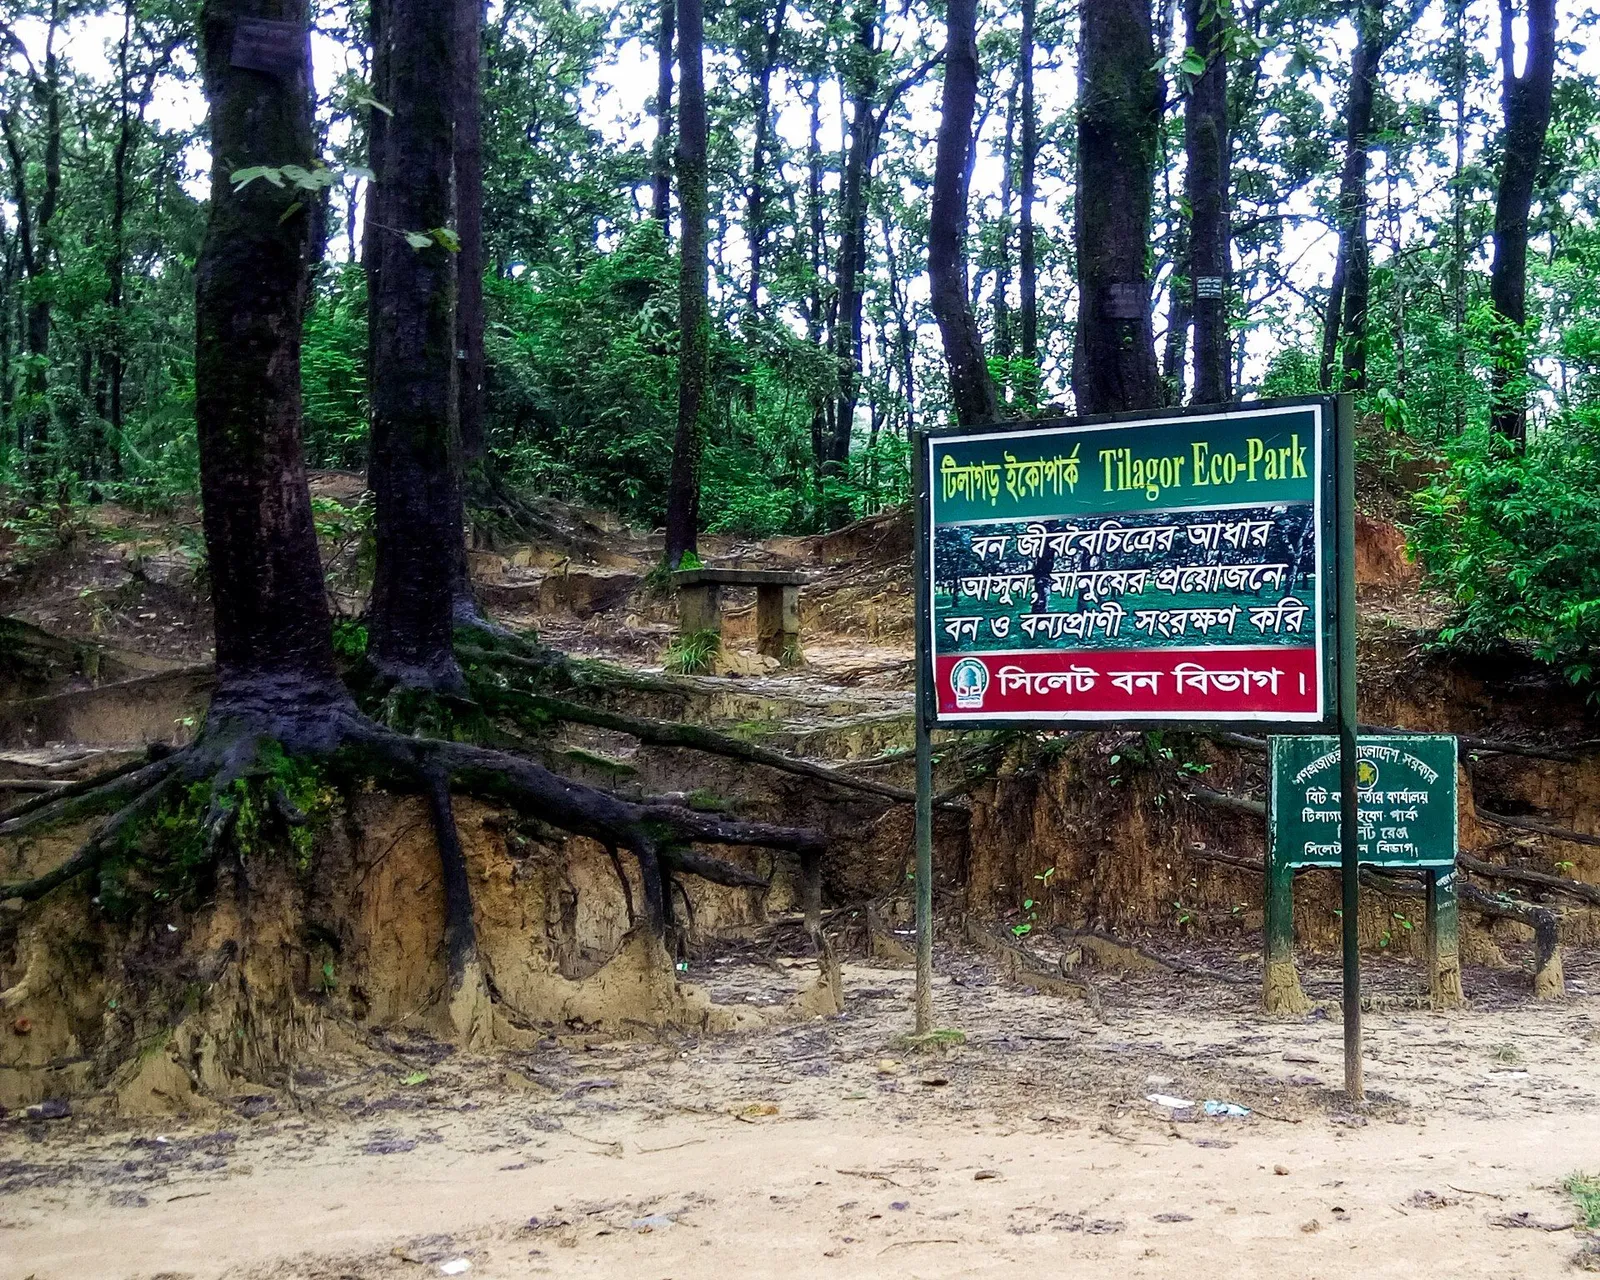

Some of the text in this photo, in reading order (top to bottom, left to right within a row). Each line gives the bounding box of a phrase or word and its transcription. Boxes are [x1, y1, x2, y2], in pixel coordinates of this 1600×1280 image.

[940, 442, 1081, 506] টিলাগড় ইকোপার্ক
[1099, 433, 1308, 501] Tilagor Eco-Park
[971, 534, 1011, 561] বন
[1186, 519, 1275, 550] আধার
[1050, 567, 1149, 603] মানুষের
[1155, 562, 1289, 594] প্রয়োজনে
[945, 596, 1310, 642] বন ও বন্যপ্রাণী সংরক্ষণ করি
[997, 664, 1100, 696] সিলেট
[1107, 671, 1164, 696] বন
[1172, 662, 1285, 696] বিভাগ
[1402, 752, 1439, 785] সরকার
